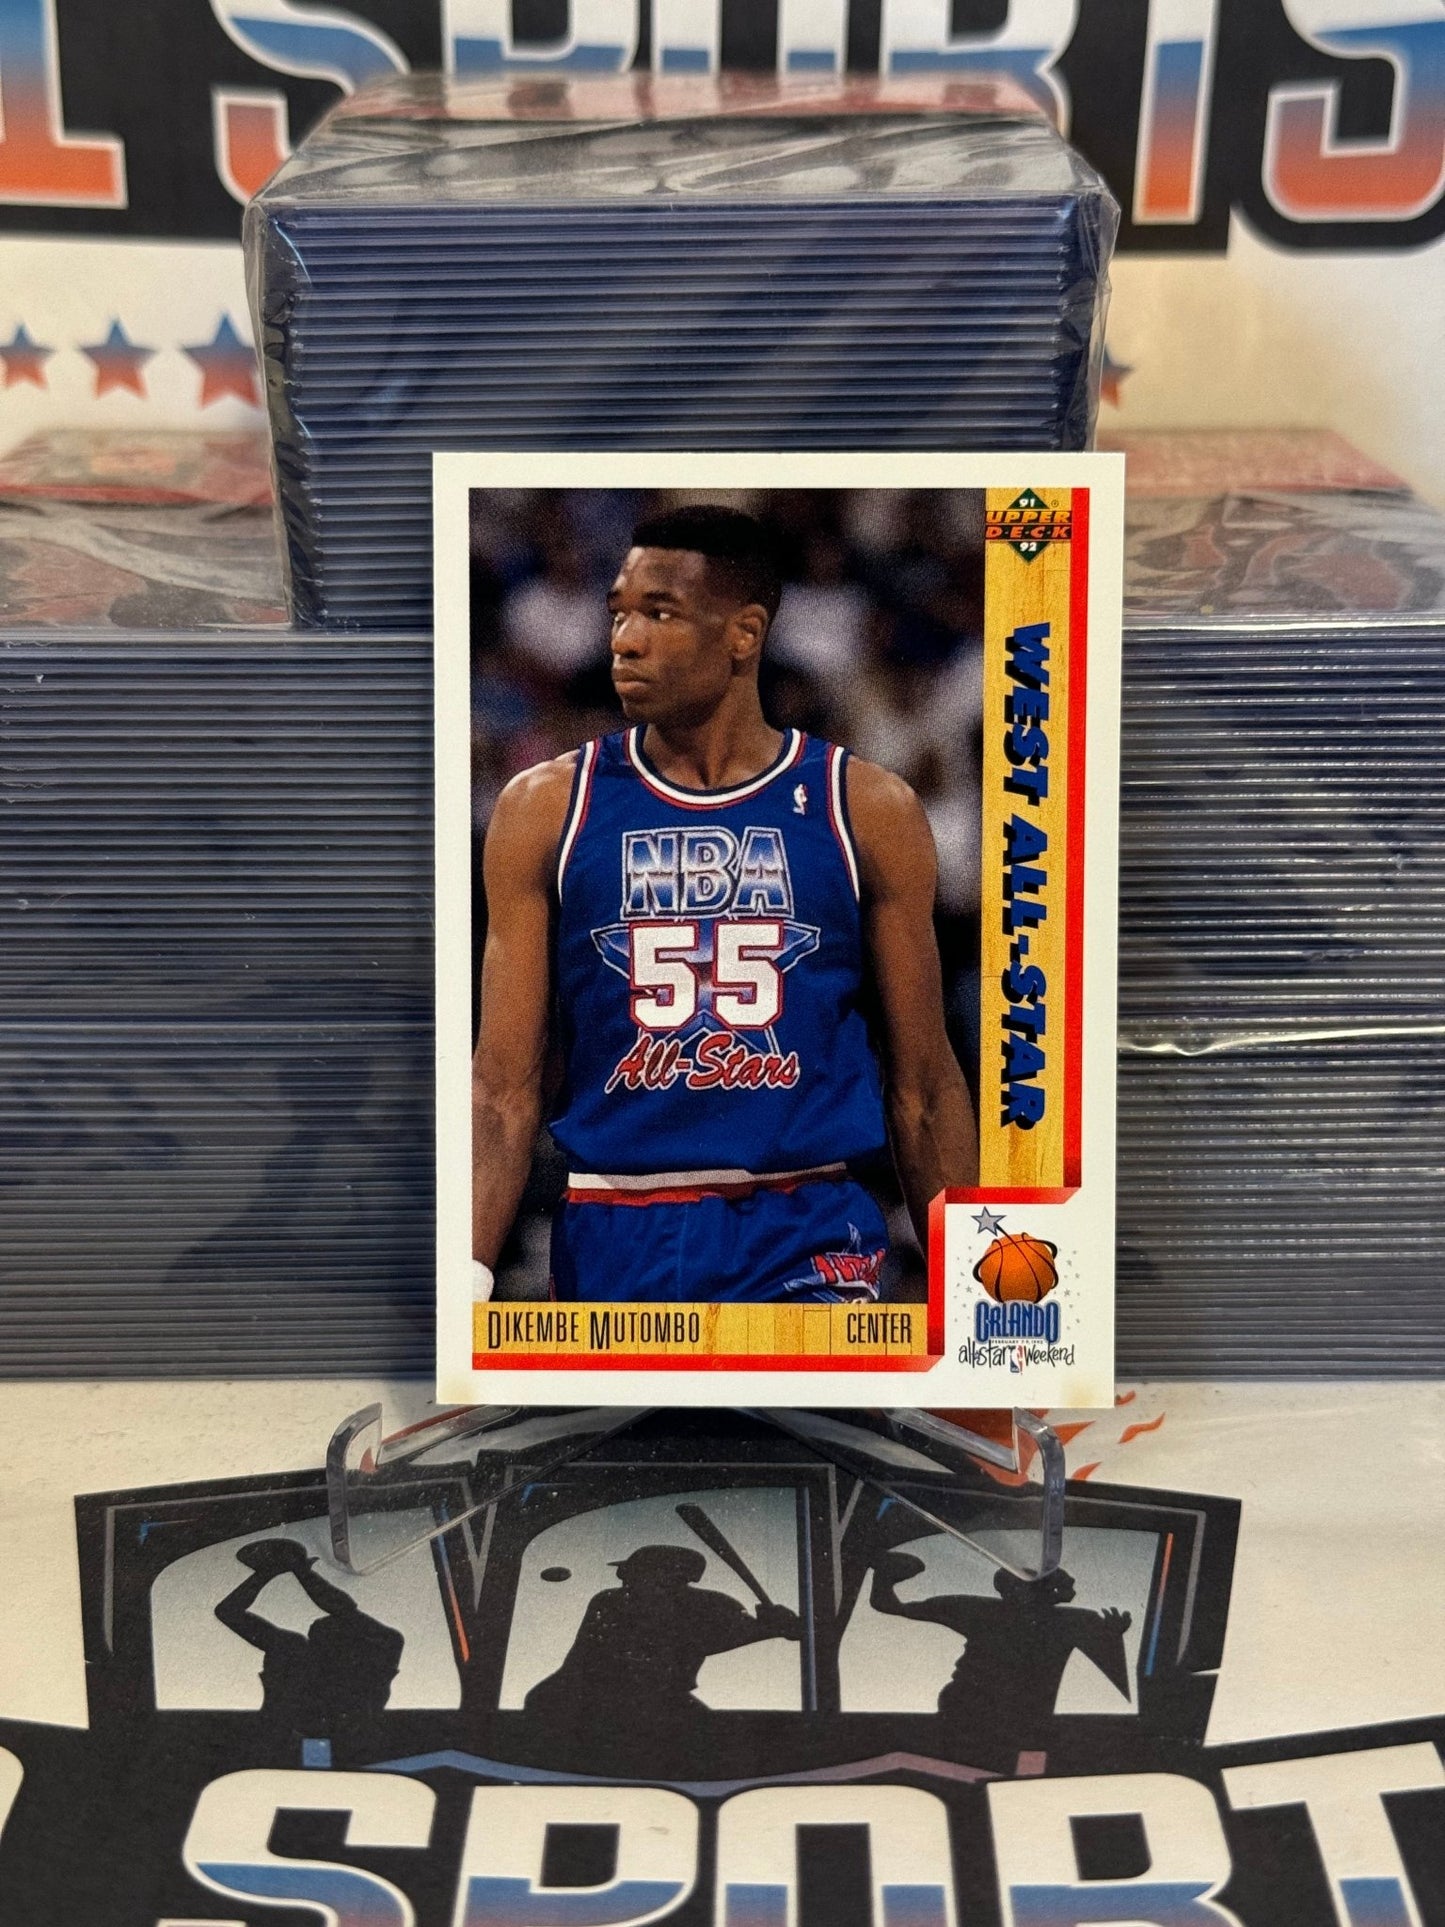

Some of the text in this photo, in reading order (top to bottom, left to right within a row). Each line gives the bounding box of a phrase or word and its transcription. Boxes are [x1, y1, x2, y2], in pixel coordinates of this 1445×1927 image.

[986, 512, 1071, 523] UPPER
[1019, 499, 1035, 507] 91
[1020, 542, 1037, 551] 92
[621, 826, 795, 920] NBA
[1001, 622, 1051, 1129] WEST ALL-STAR
[629, 920, 784, 1032] 55
[604, 1034, 800, 1094] All-Stars
[488, 1311, 700, 1349] DIKEMBE MUTOMBO
[847, 1313, 911, 1344] CENTER
[974, 1300, 1060, 1344] ORLANDO
